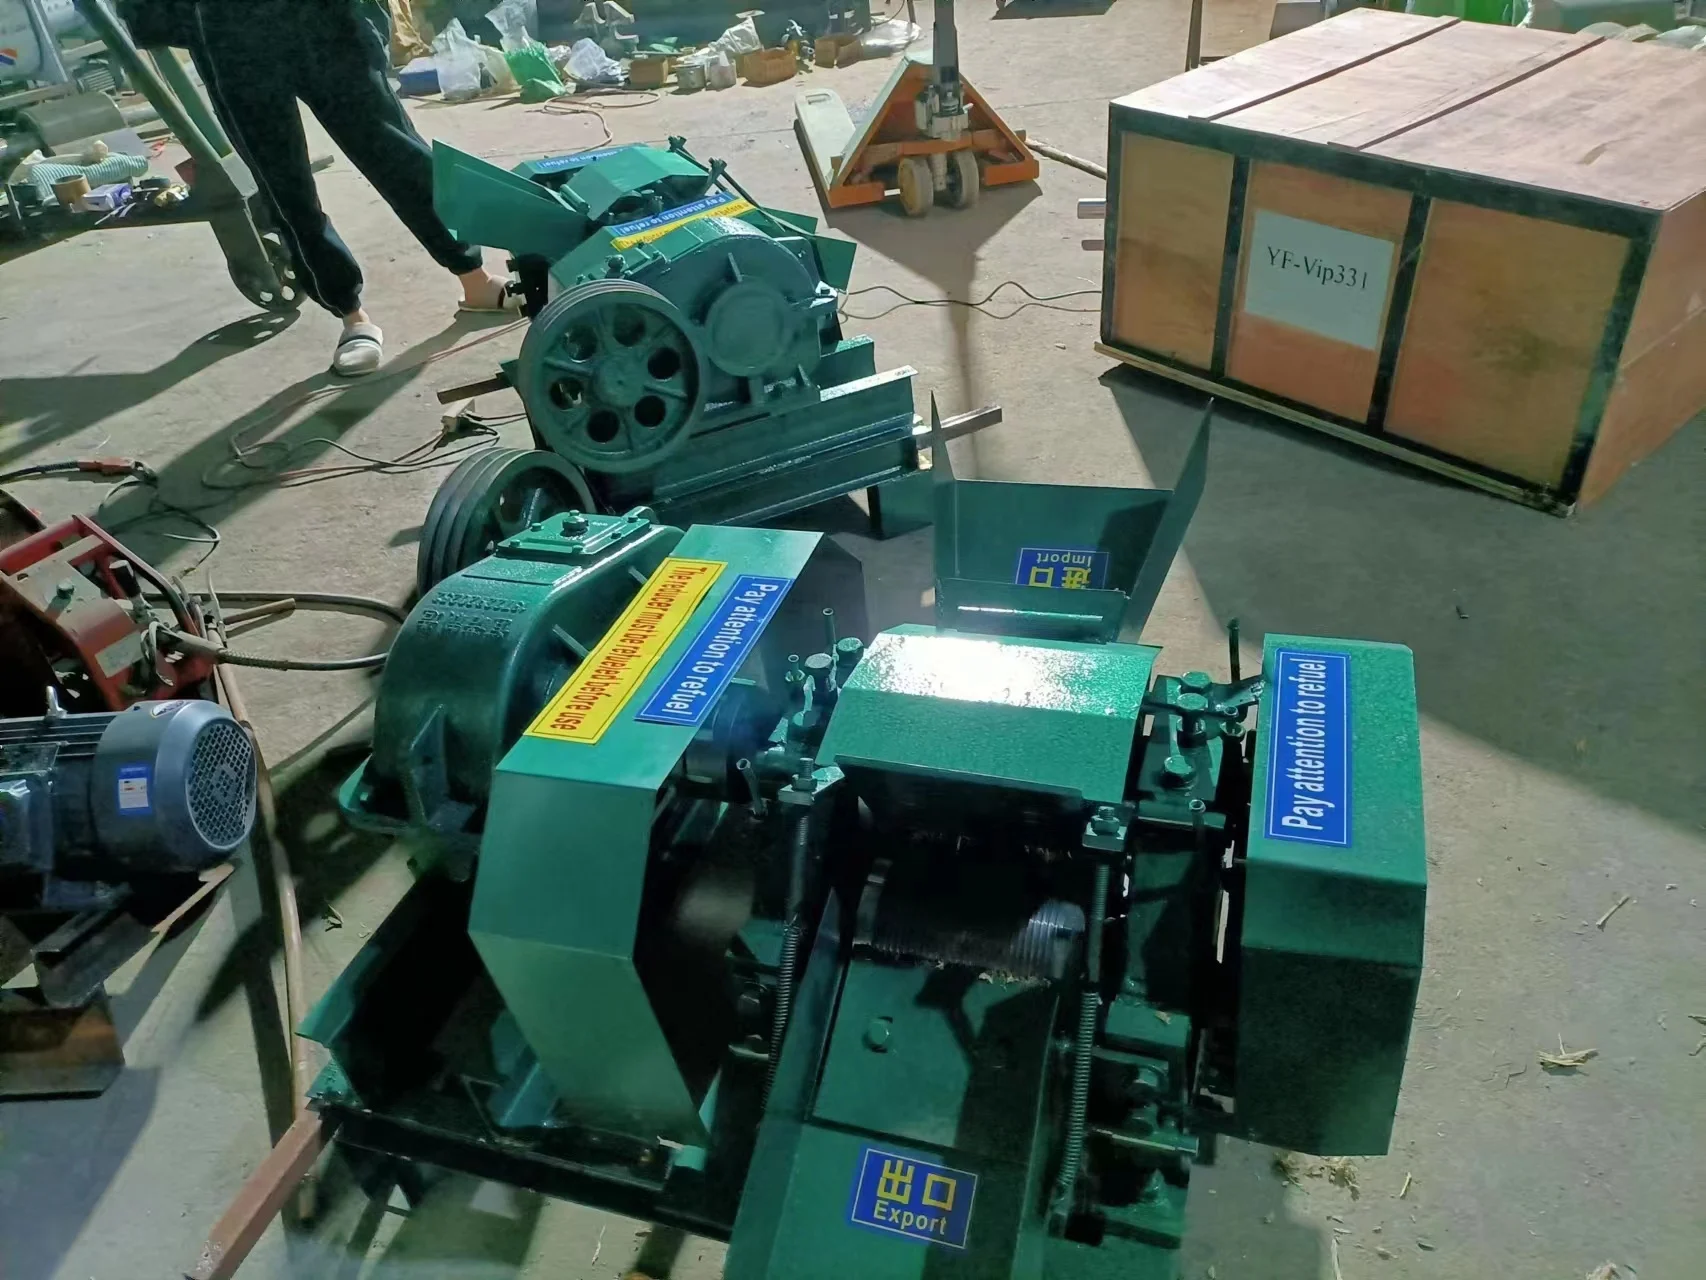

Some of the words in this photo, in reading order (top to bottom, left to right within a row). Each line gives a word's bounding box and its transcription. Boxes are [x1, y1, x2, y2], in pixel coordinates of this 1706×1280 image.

[660, 203, 706, 220] attention
[705, 196, 726, 206] Pay
[620, 219, 651, 234] refuel
[650, 216, 663, 225] to
[1267, 246, 1368, 290] YF-Vip331
[668, 566, 708, 580] The
[645, 581, 689, 612] reducer
[734, 583, 779, 605] Pay
[627, 611, 665, 633] must
[702, 605, 757, 659] attention
[619, 633, 657, 644] be
[591, 644, 642, 681] refueled
[692, 661, 725, 674] to
[1288, 657, 1326, 697] refuel
[565, 681, 621, 711] before
[661, 675, 708, 716] refuel
[1288, 700, 1326, 715] to
[550, 711, 588, 731] use
[1285, 718, 1326, 792] attention
[1281, 794, 1335, 830] Pay
[876, 1159, 957, 1212] 出口
[873, 1199, 947, 1236] Export
